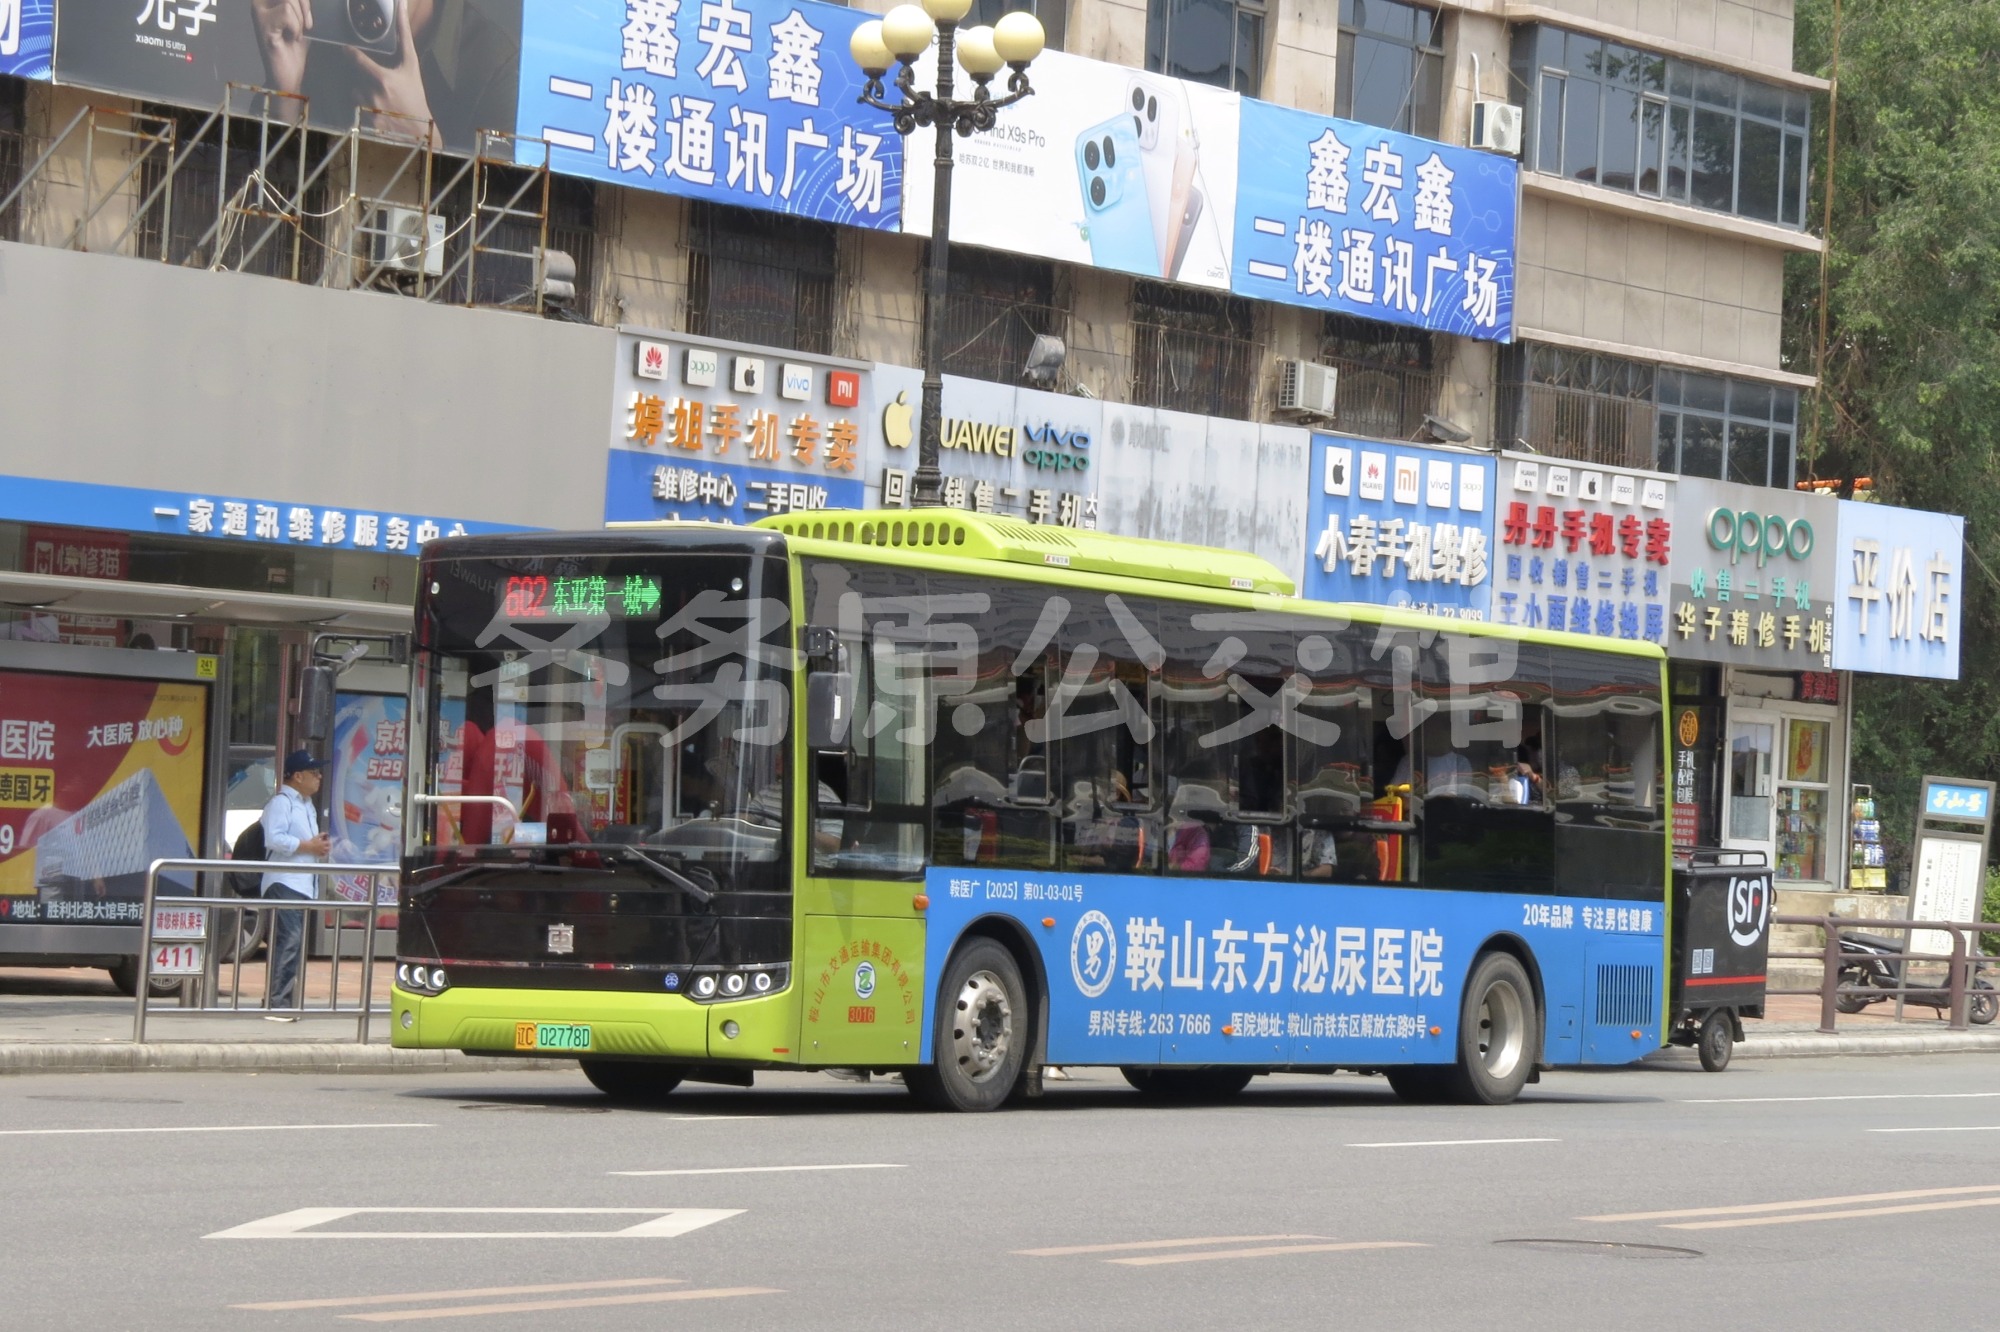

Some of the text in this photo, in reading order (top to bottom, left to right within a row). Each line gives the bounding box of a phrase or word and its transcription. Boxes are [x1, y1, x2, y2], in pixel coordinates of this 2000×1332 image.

[621, 0, 824, 106] 鑫宏鑫
[543, 76, 884, 214] 二楼通讯广场
[984, 123, 1006, 140] ind
[1007, 124, 1026, 144] X9s
[1028, 129, 1046, 148] Pro
[1306, 127, 1455, 236] 鑫宏鑫
[1248, 216, 1499, 328] 二楼通讯广场
[786, 373, 810, 391] vivo
[626, 391, 859, 472] 婷姐手机专卖
[939, 416, 1018, 457] UAWEI
[1024, 421, 1091, 448] vivo
[654, 465, 828, 513] 维修中心 二手回收
[883, 468, 1082, 528] 回销售二手机
[1362, 481, 1383, 491] HUAWEI
[1430, 480, 1450, 491] vivo
[1648, 491, 1664, 500] vivo
[1315, 513, 1488, 587] 小春手机维修
[1503, 501, 1671, 566] 丹丹手机专卖
[506, 575, 548, 617] 602
[1506, 554, 1659, 597] 回收销售二手机
[1690, 566, 1811, 611] 收售二手机
[1848, 537, 1952, 644] 平价店
[1674, 601, 1826, 654] 华子精修手机
[1, 719, 55, 761] 医院
[87, 722, 133, 749] 大医院
[368, 758, 403, 778] 5/29
[1677, 769, 1694, 786] 配件
[1678, 750, 1697, 769] 手机
[0, 774, 51, 803] 德国牙
[156, 912, 203, 931] 请您排队乘车
[1523, 902, 1653, 932] 20年品牌 专注男性健康
[156, 946, 193, 967] 411
[1124, 916, 1445, 998] 鞍山东方泌尿医院
[808, 939, 915, 1024] 鞍山市交通运输集团有限公司
[849, 1007, 875, 1022] 3016
[1148, 1013, 1174, 1035] 263
[1178, 1014, 1211, 1035] 7666
